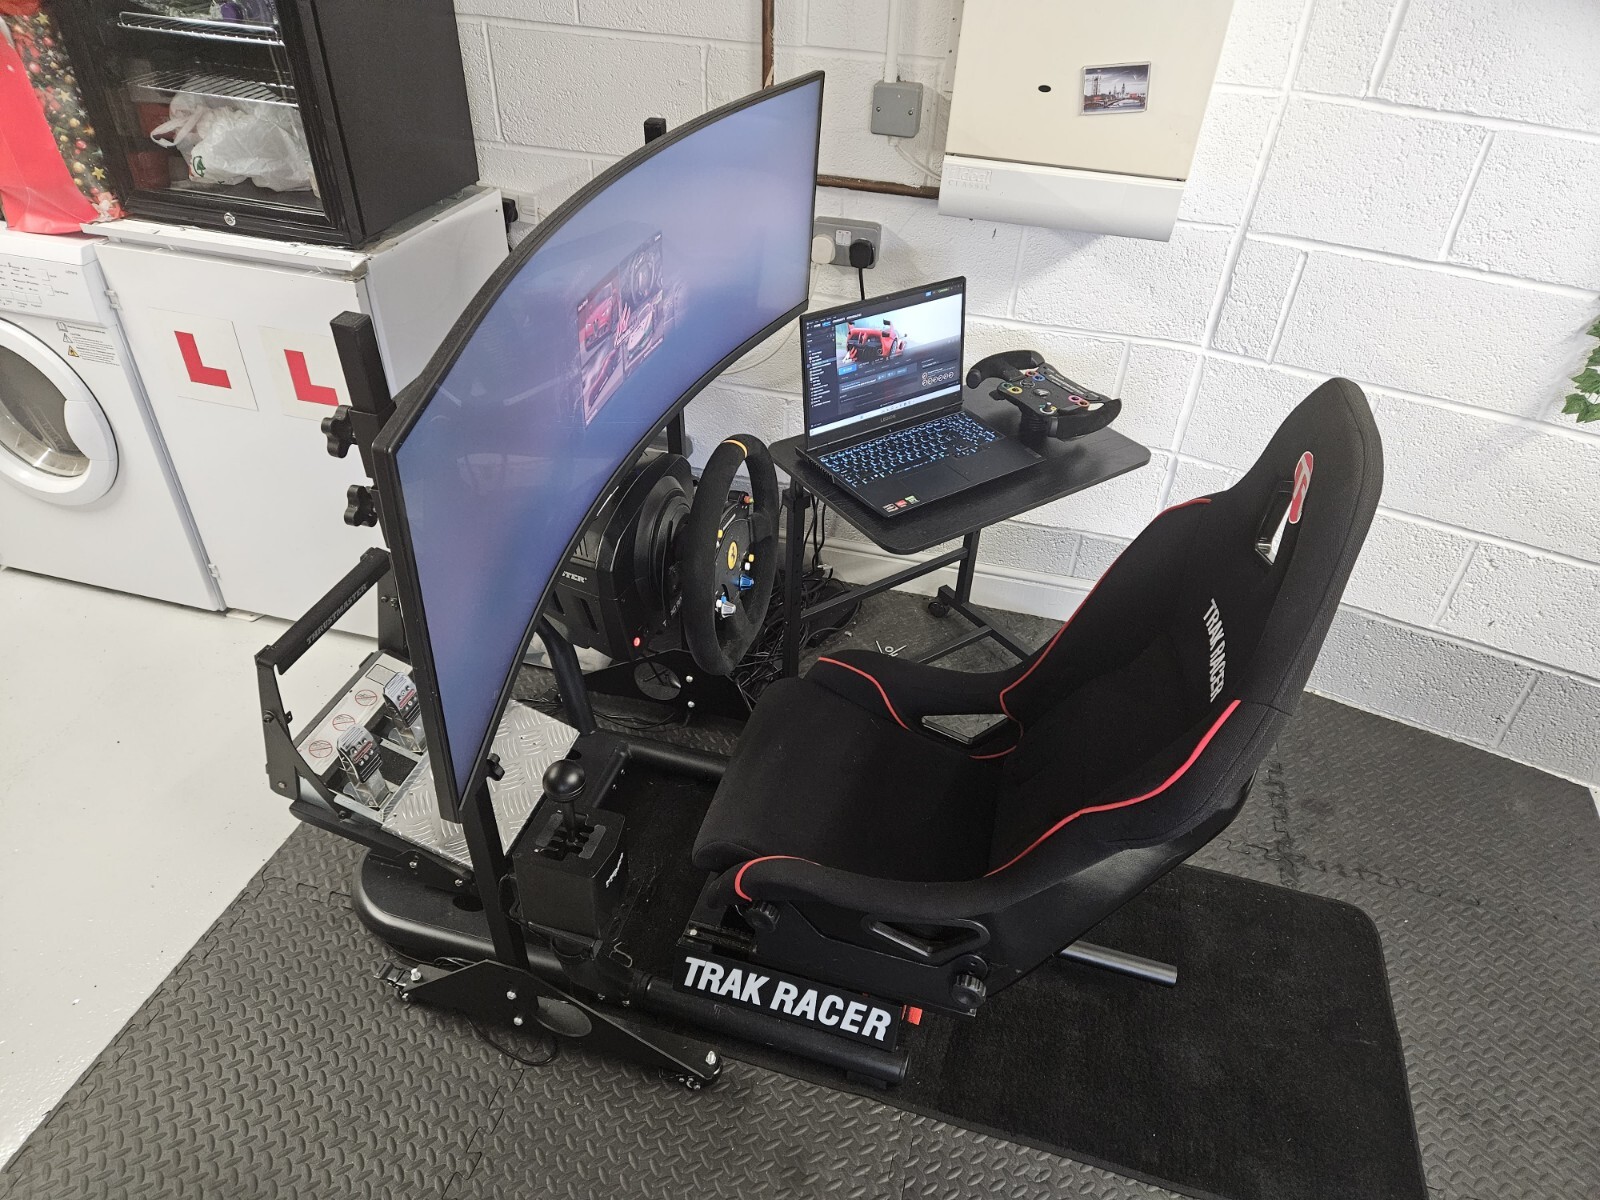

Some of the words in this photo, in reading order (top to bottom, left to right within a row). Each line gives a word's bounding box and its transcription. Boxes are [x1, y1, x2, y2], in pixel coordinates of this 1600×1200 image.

[174, 331, 232, 389] L
[284, 349, 340, 407] L
[306, 583, 367, 645] THRUSTMASTER
[1203, 598, 1225, 651] TRAK
[1209, 640, 1226, 703] RACER
[683, 956, 770, 1006] TRAK
[769, 980, 892, 1042] RACER
